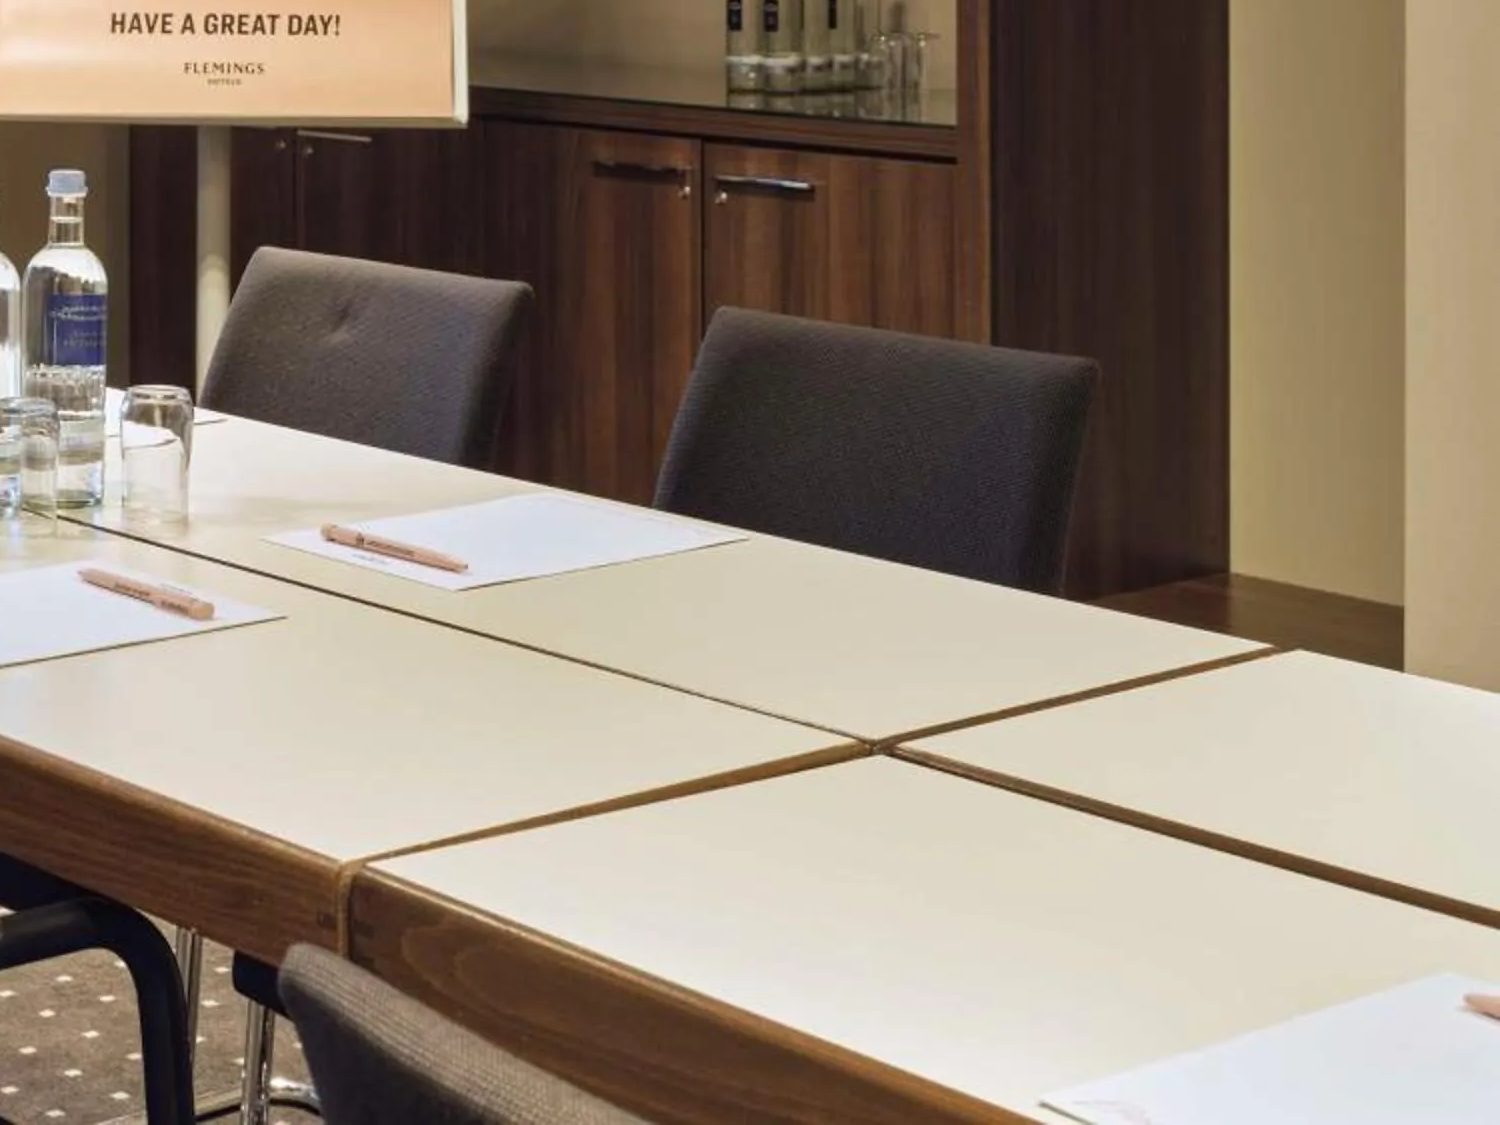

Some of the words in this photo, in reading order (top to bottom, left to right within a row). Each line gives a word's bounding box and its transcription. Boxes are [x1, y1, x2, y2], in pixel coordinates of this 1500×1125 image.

[110, 12, 174, 35] HAVE
[180, 13, 196, 35] A
[203, 13, 280, 36] GREAT
[287, 14, 341, 37] DAY!
[184, 62, 265, 75] FLEMINGS
